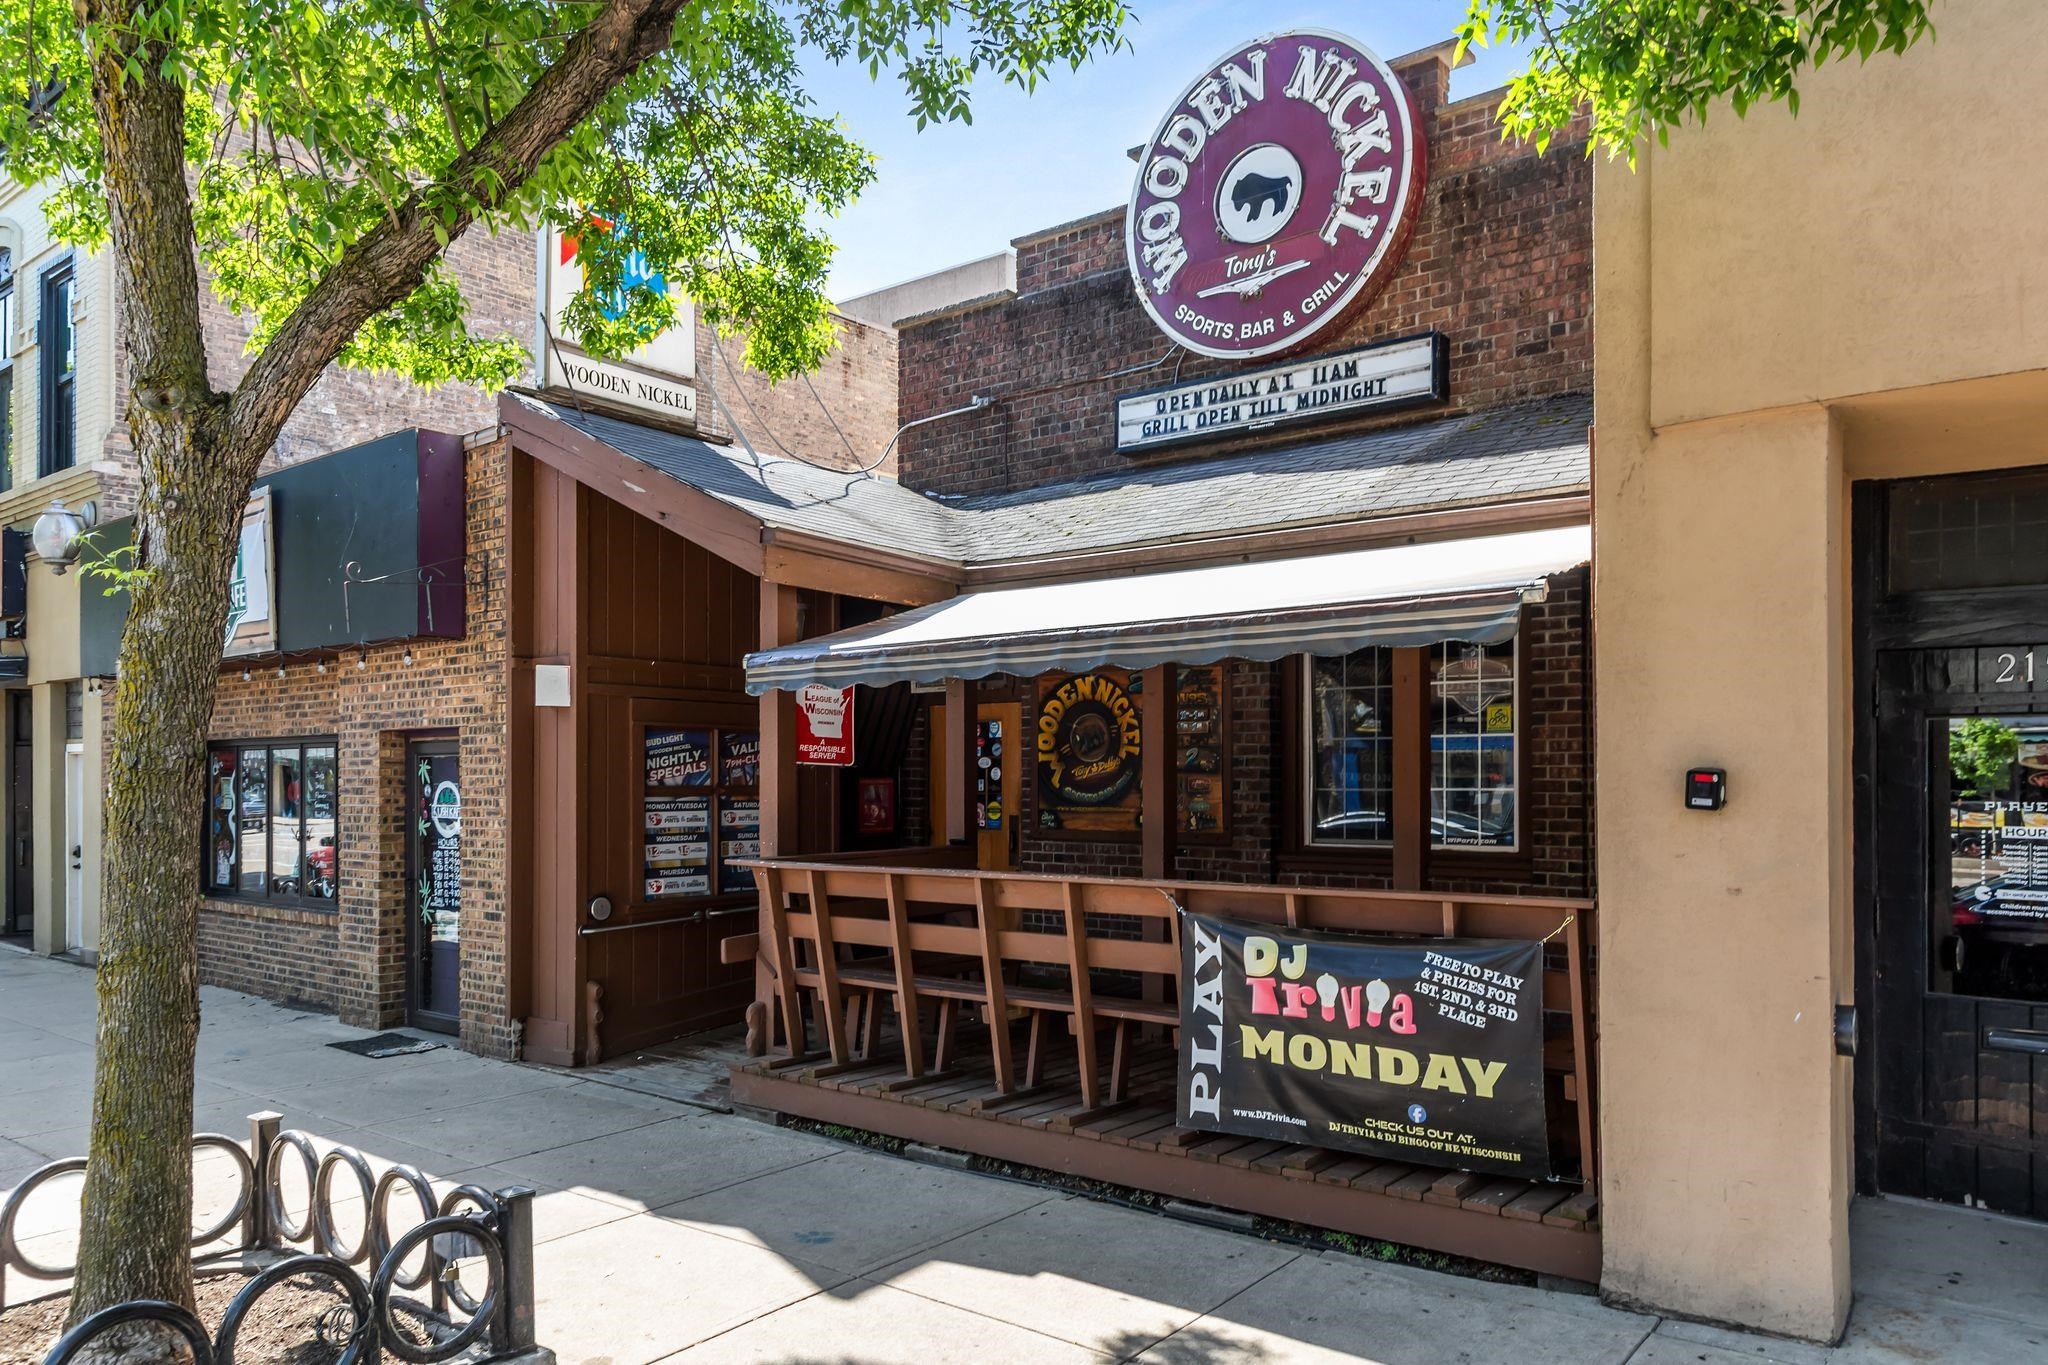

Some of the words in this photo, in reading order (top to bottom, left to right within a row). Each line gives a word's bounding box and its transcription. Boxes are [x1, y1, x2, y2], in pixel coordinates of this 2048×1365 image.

[1137, 50, 1267, 295] WOODEN
[1283, 46, 1392, 247] NICKEL
[1225, 244, 1277, 278] Tony's
[1175, 304, 1234, 339] SPORTS
[1241, 318, 1275, 339] BAR
[1283, 311, 1296, 327] &
[1302, 272, 1350, 314] GRILL
[564, 362, 631, 396] WOODEN
[637, 384, 692, 412] NICKEL
[1156, 391, 1203, 415] OPEN
[1208, 379, 1260, 405] DAILY
[1267, 373, 1294, 394] AT
[1142, 415, 1188, 439] GRILL
[1196, 405, 1241, 429] OPEN
[1249, 398, 1287, 419] TILL
[1297, 378, 1387, 411] MIDNIGHT
[1996, 652, 2048, 683] 21
[805, 691, 832, 703] LEAGUE
[805, 703, 844, 716] WISCONSIN
[646, 738, 662, 747] BUD
[662, 734, 684, 744] LIGHT
[1038, 676, 1097, 789] WOODEN
[1095, 678, 1140, 760] NICKEL
[646, 750, 702, 770] NIGHTLY
[731, 742, 760, 756] VALI
[800, 744, 846, 754] RESPONSIBLE
[809, 752, 836, 760] SERVER
[650, 761, 707, 781] SPECIALS
[646, 802, 707, 810] MONDAY/TUESDAY
[656, 834, 698, 842] WEDNESDAY
[2005, 828, 2047, 838] HOUR
[660, 868, 695, 876] THURSDAY
[1243, 936, 1308, 980] DJ
[1424, 952, 1462, 972] FREE
[1462, 962, 1481, 978] TO
[1482, 968, 1524, 991] PLAY
[1421, 967, 1432, 980] &
[1432, 970, 1486, 996] PRIZES
[1486, 986, 1517, 1006] FOR
[1414, 981, 1440, 1000] 1ST,
[1442, 989, 1474, 1011] 2ND,
[1475, 1000, 1487, 1013] &
[1488, 1003, 1518, 1022] 3RD
[1190, 922, 1223, 1122] PLAY
[1438, 1004, 1487, 1029] PLACE
[1239, 1024, 1507, 1099] MONDAY
[1233, 1108, 1307, 1127] www.DJTrivia.com
[1365, 1118, 1404, 1133] CHECK
[1406, 1126, 1425, 1136] US
[1428, 1129, 1454, 1141] OUT
[1456, 1134, 1477, 1145] AT:
[1328, 1121, 1342, 1132] DJ
[1342, 1124, 1376, 1140] TRIVIA
[1376, 1131, 1384, 1141] &
[1384, 1132, 1397, 1143] DJ
[1398, 1135, 1430, 1149] BINGO
[1430, 1140, 1443, 1151] OF
[1445, 1143, 1461, 1153] NE
[1462, 1145, 1521, 1162] WISCONSIN
